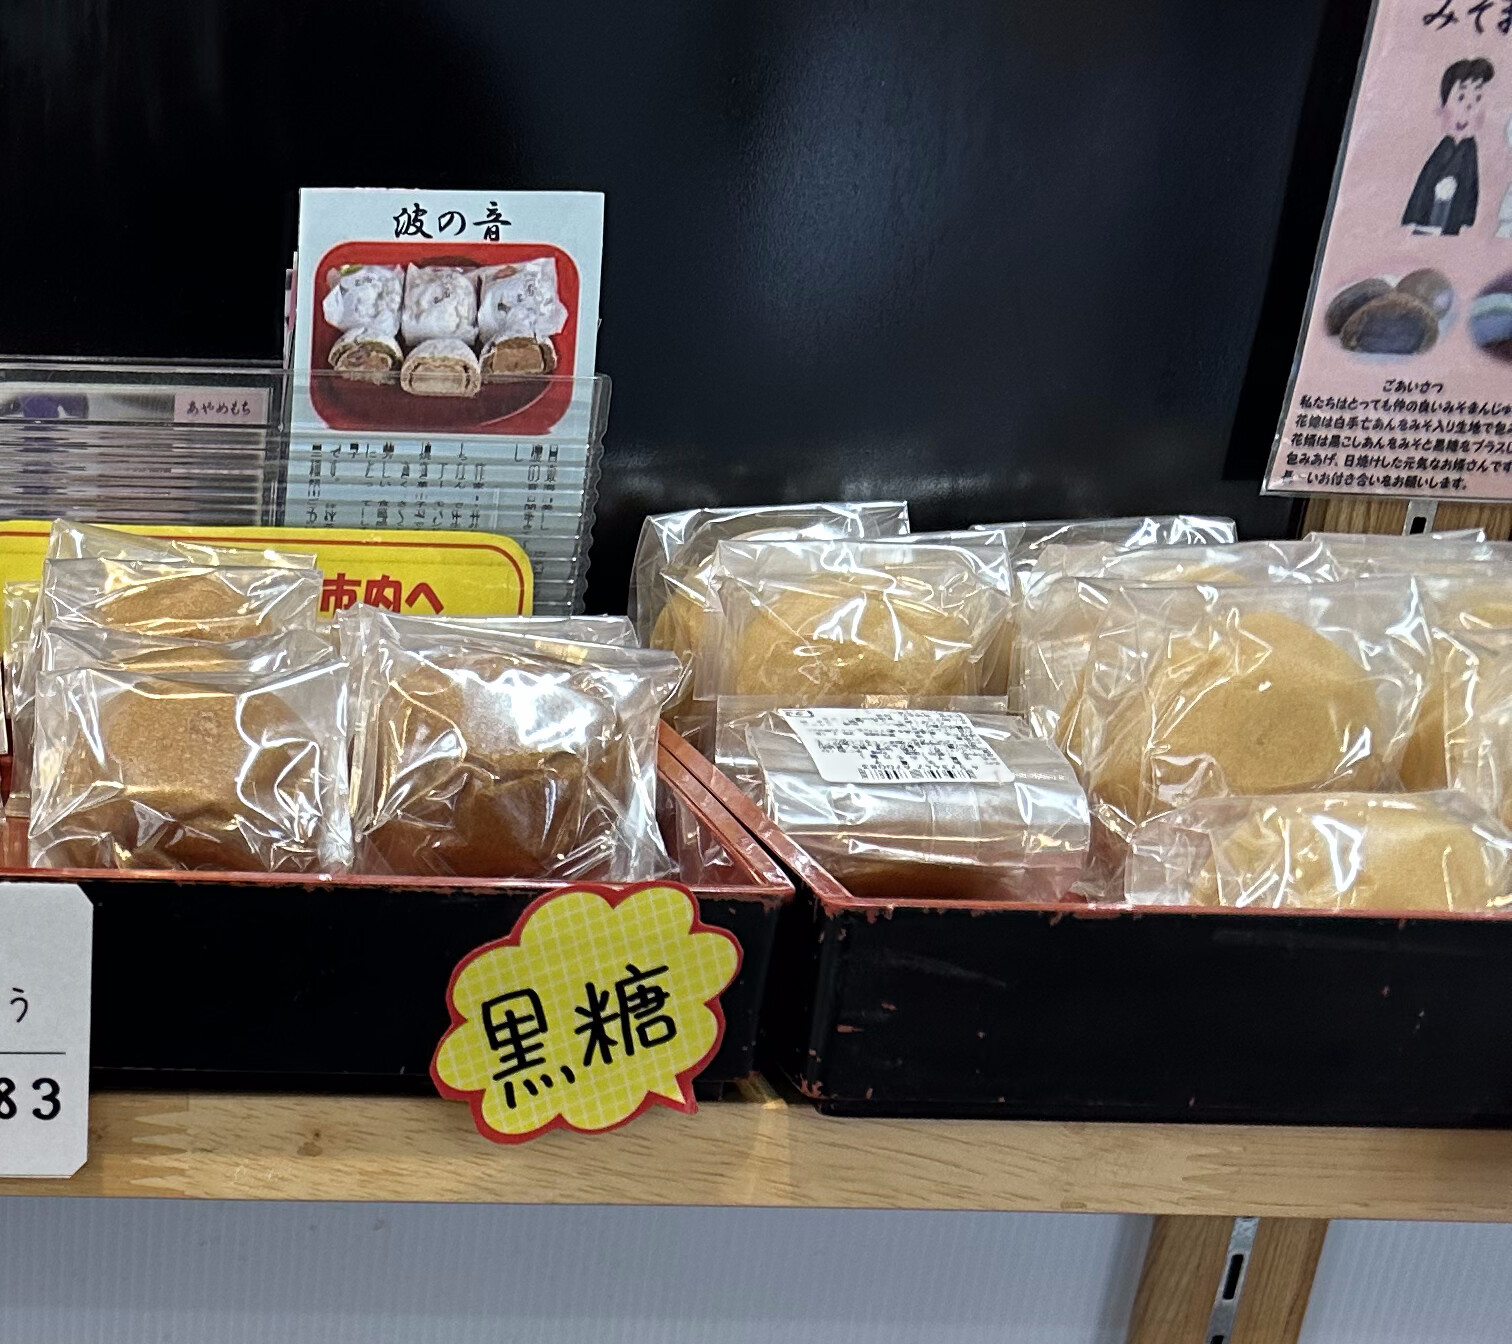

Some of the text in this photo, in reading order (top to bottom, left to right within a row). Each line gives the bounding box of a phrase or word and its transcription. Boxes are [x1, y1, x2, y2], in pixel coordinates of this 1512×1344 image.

[393, 201, 512, 242] 波の音
[1383, 379, 1444, 394] ごあいさつ
[186, 399, 251, 417] あやめもち
[481, 964, 678, 1109] 黒糖
